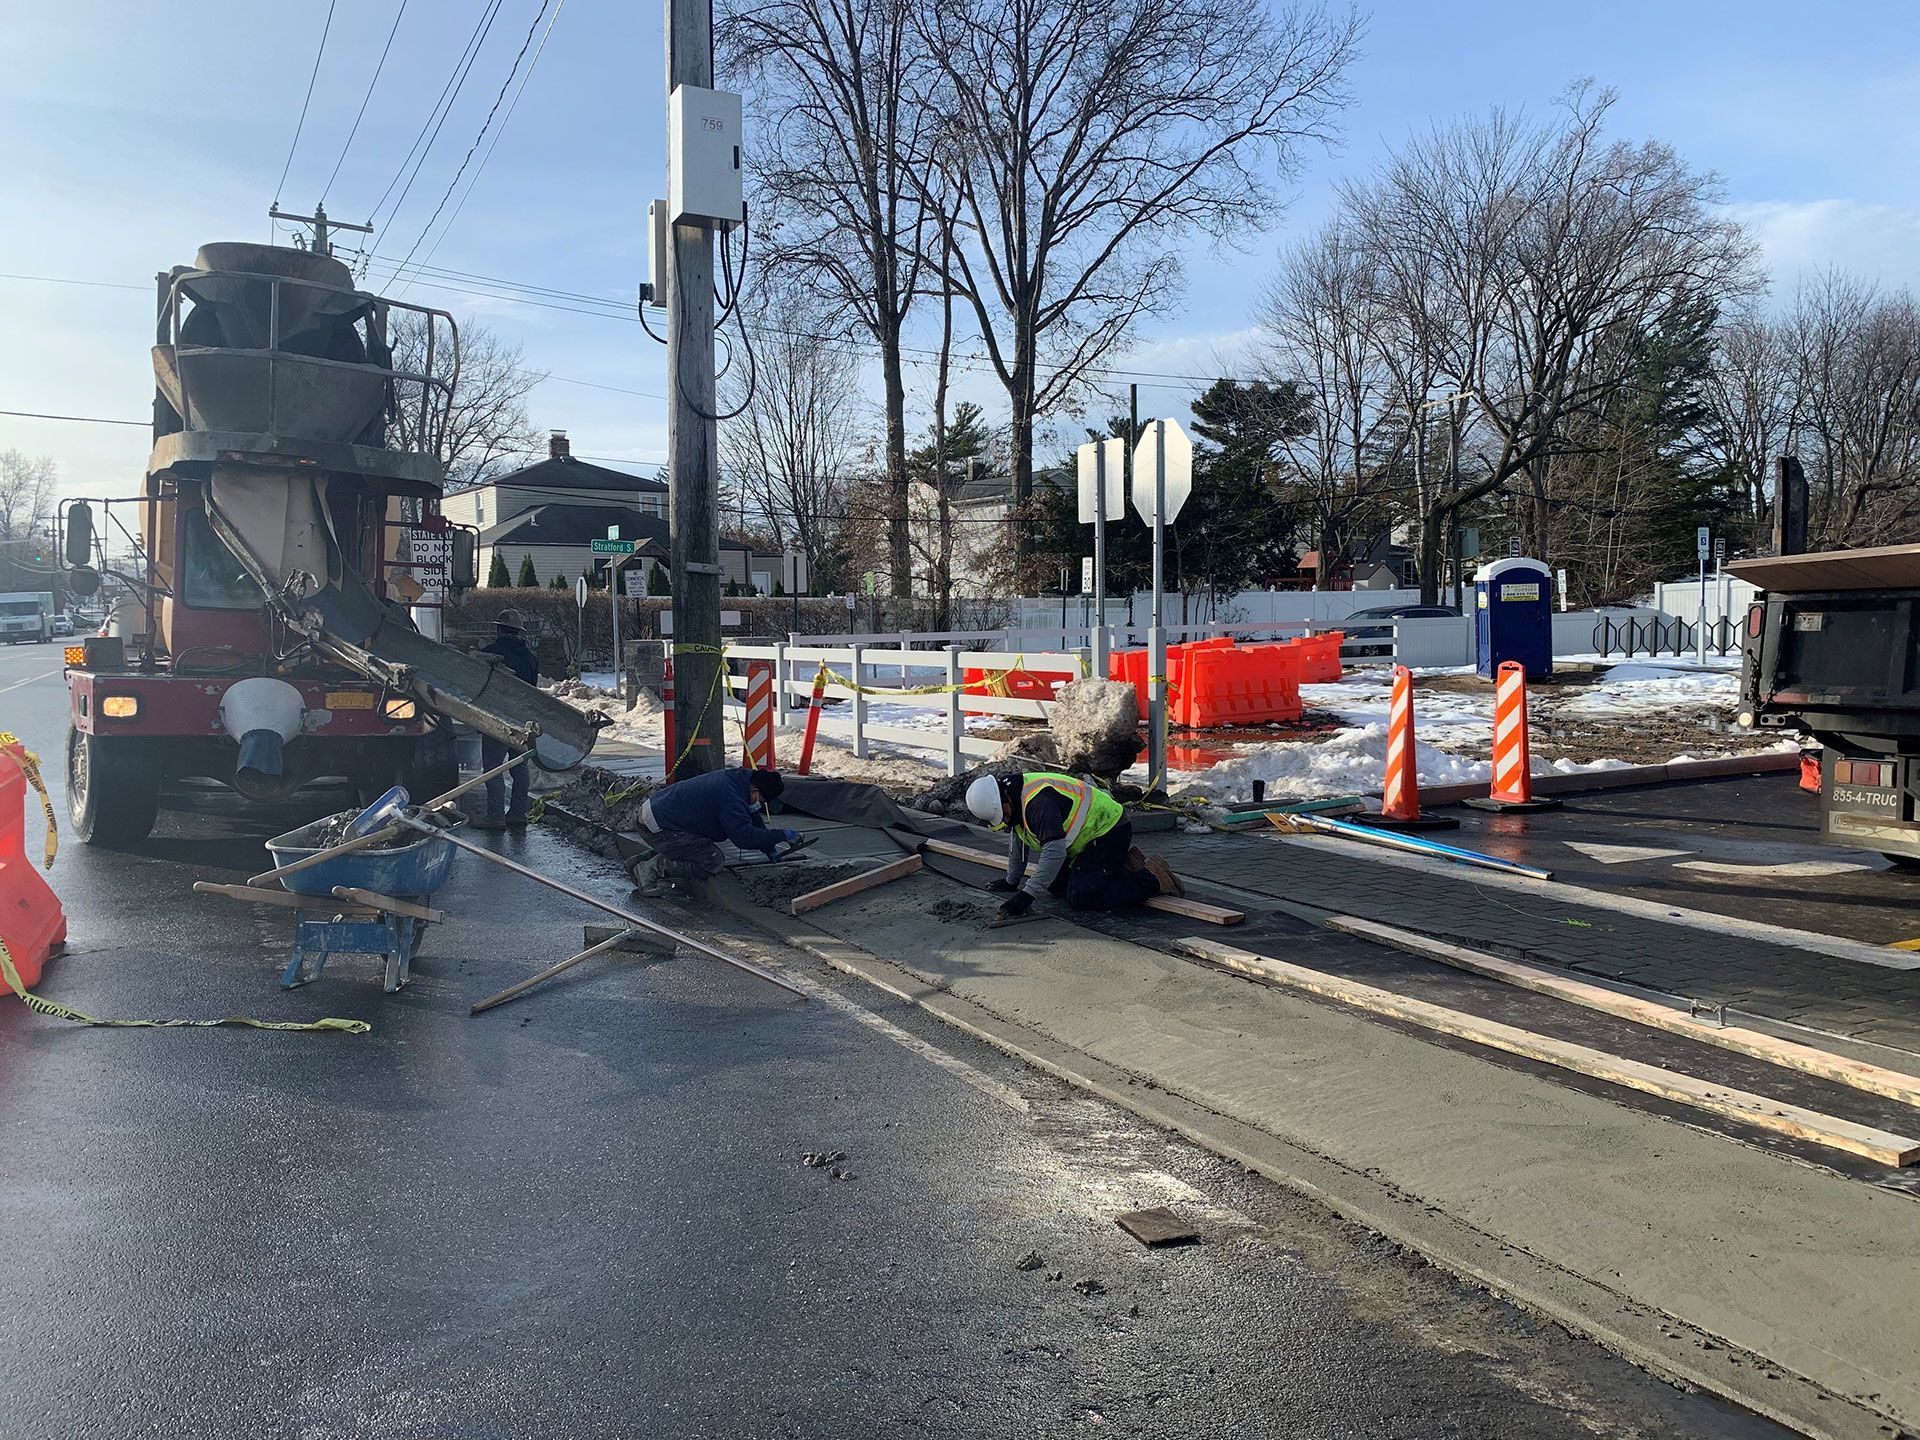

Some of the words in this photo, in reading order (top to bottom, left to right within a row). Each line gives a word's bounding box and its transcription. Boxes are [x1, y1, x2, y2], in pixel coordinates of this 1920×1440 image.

[702, 118, 723, 131] 759
[413, 543, 430, 552] DO
[593, 542, 624, 551] Stratford
[416, 555, 454, 564] BLOCK
[423, 567, 448, 576] SIDE
[421, 578, 451, 587] ROAD
